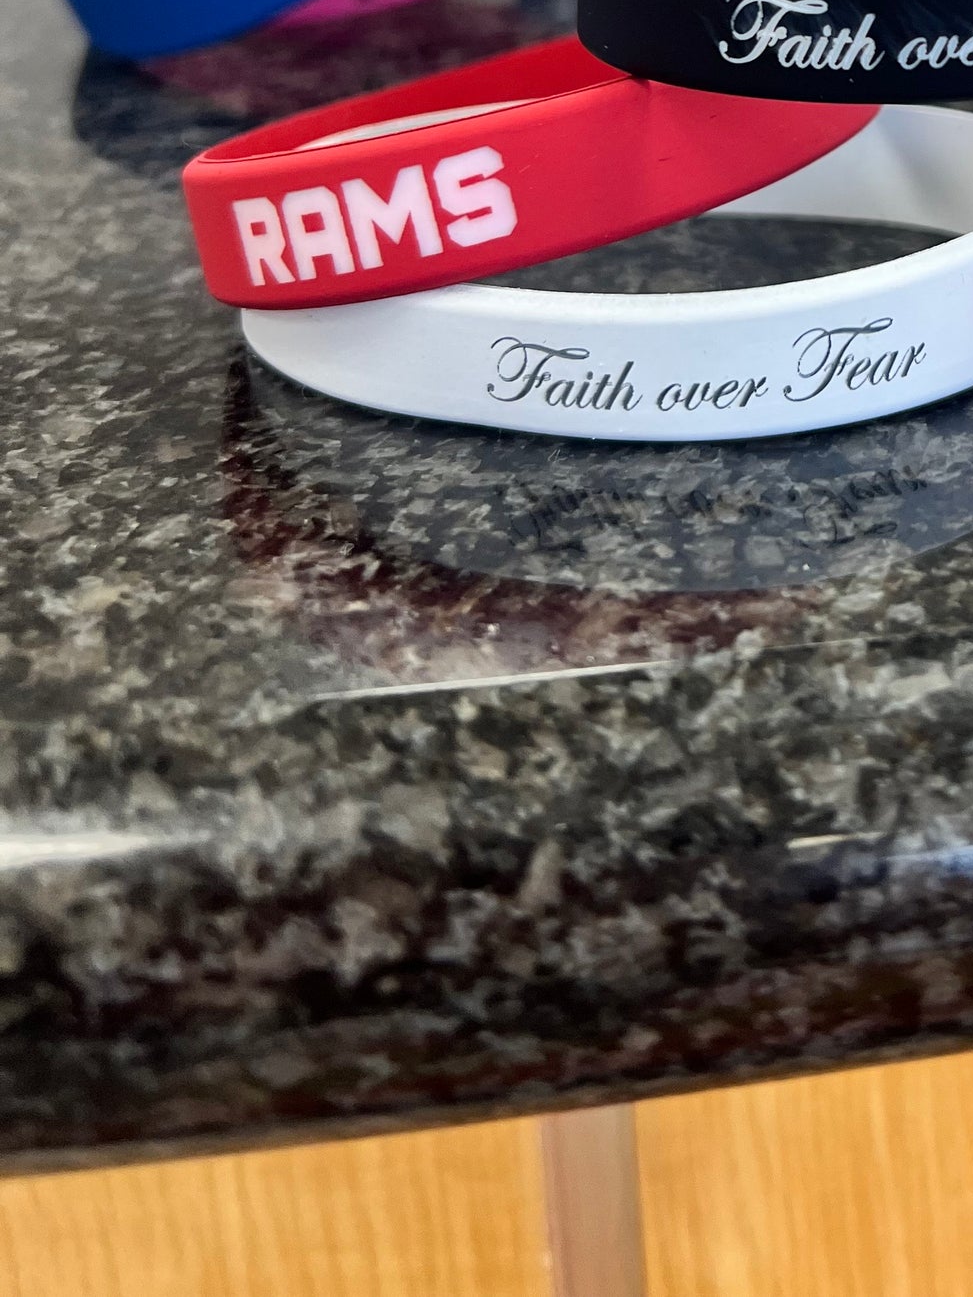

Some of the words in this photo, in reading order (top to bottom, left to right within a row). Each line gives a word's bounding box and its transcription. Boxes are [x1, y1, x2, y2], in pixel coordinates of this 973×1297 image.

[234, 145, 518, 288] RAMS
[487, 336, 643, 411] Faith
[656, 374, 769, 412] over
[783, 317, 927, 403] Fear
